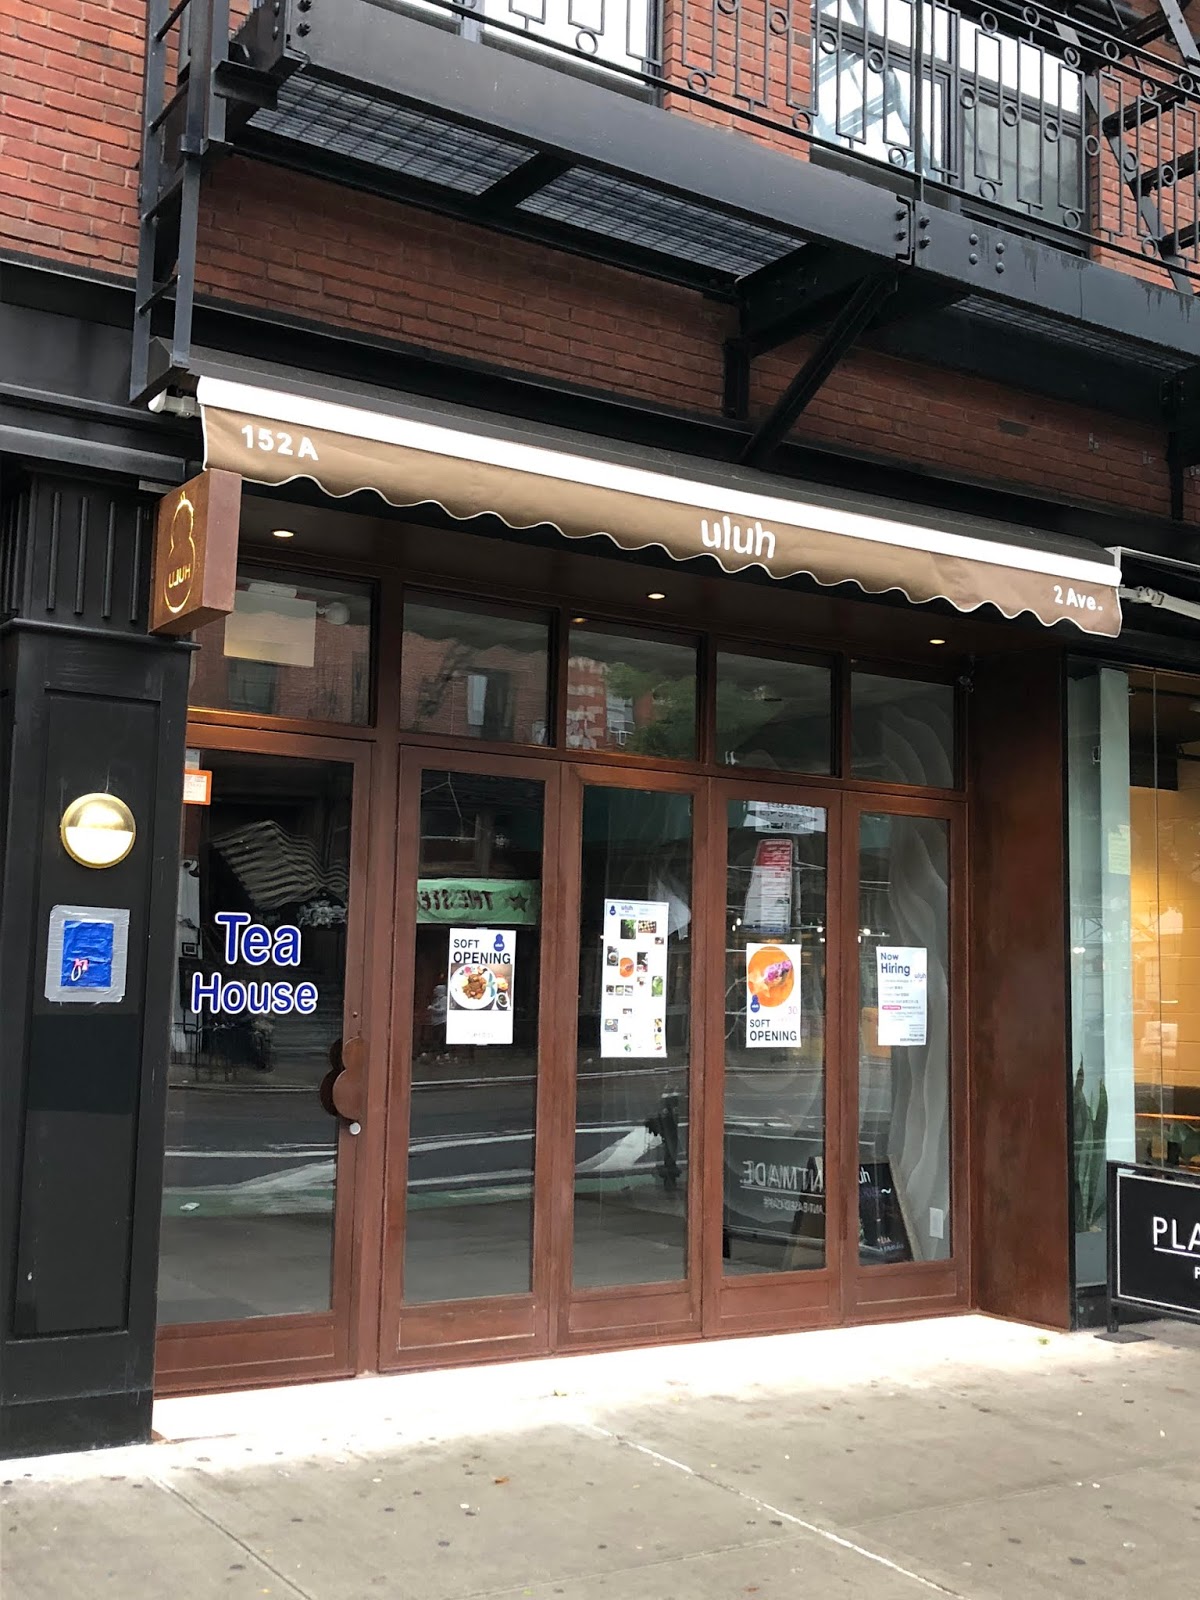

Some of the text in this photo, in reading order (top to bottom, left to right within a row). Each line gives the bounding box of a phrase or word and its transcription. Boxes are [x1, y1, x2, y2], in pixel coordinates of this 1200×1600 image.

[241, 424, 319, 461] 152A
[701, 515, 776, 559] uluh
[1053, 584, 1103, 611] 2 Ave.
[215, 911, 302, 966] Tea
[453, 938, 480, 949] SOFT
[453, 951, 511, 965] OPENING
[880, 952, 899, 960] Now
[880, 962, 911, 977] Hiring
[191, 971, 319, 1014] House
[749, 1019, 771, 1028] SOFT
[749, 1030, 798, 1042] OPENING
